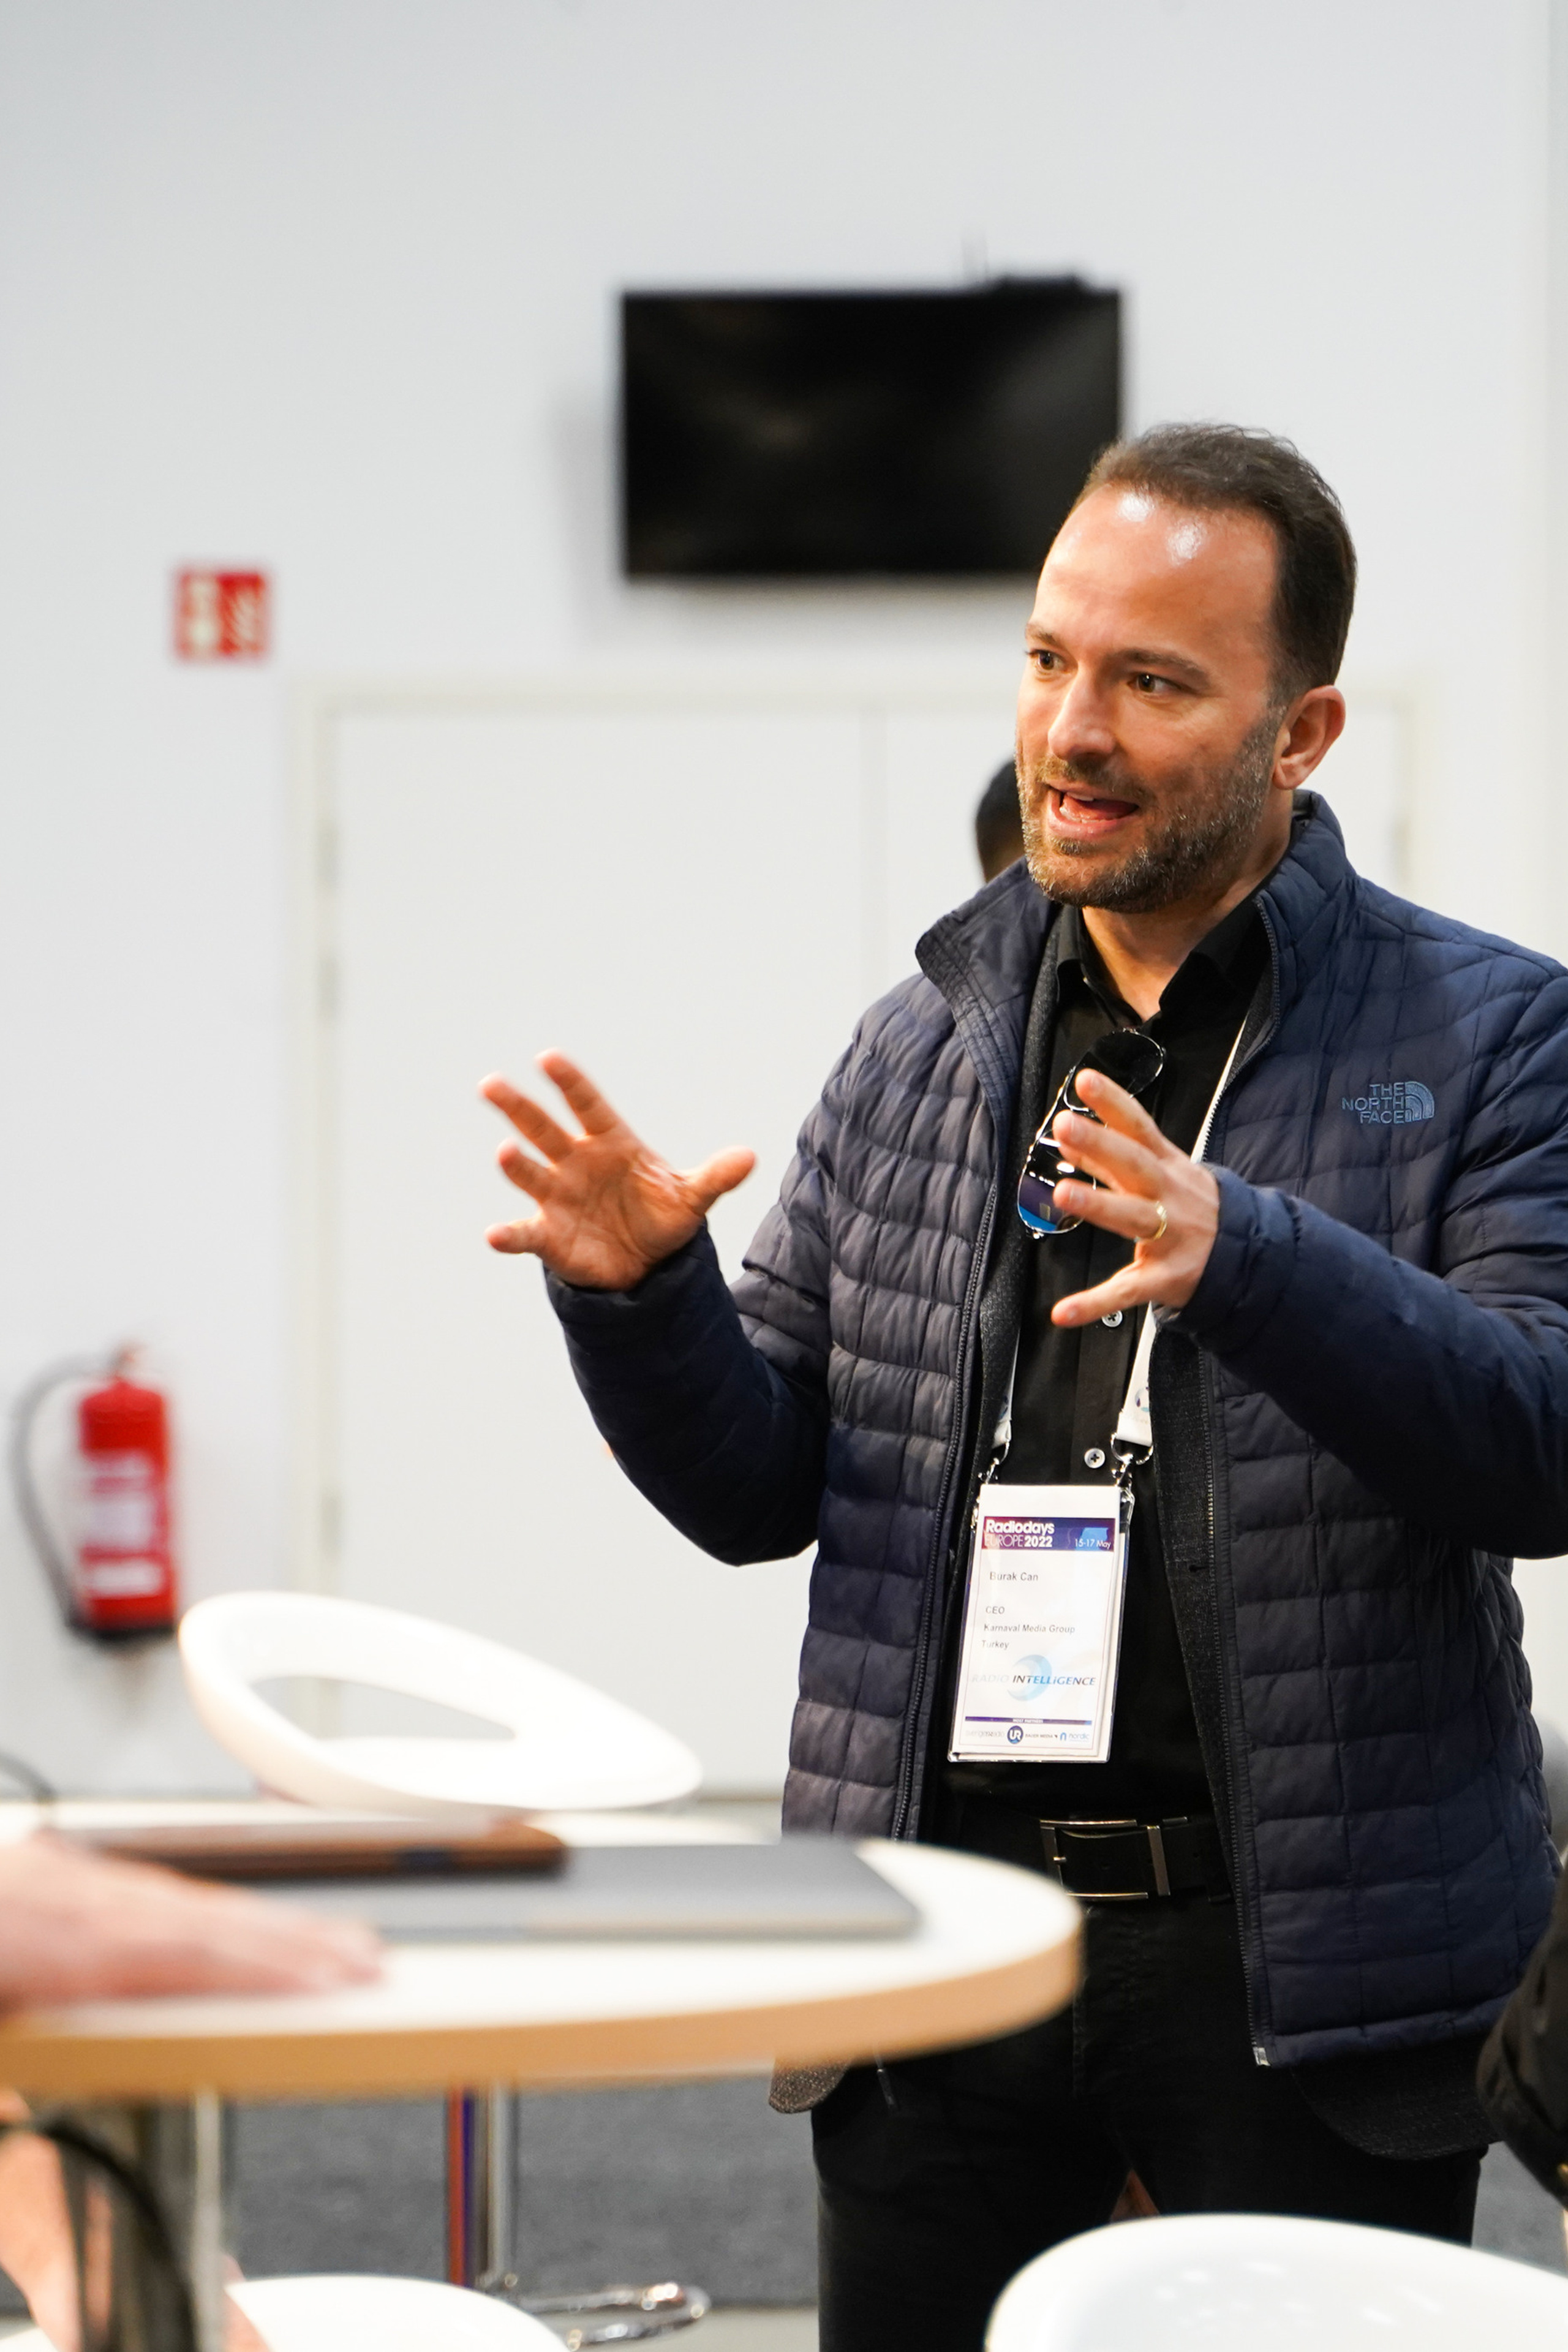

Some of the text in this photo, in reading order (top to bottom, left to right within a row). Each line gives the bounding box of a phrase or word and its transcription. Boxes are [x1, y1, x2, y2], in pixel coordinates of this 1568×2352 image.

[1369, 1082, 1404, 1096] THE
[1341, 1096, 1404, 1111] NORTH
[1360, 1110, 1404, 1124] FACE
[986, 1519, 1055, 1536] Radiodays
[984, 1534, 1053, 1547] EUROPE 2022
[1075, 1538, 1111, 1550] 15-17 May
[989, 1571, 1039, 1581] Burak Can
[985, 1605, 1005, 1615] CEO
[983, 1623, 1076, 1635] Karnaval Media Group
[982, 1639, 1009, 1650] Turkey
[1009, 1728, 1021, 1740] UR
